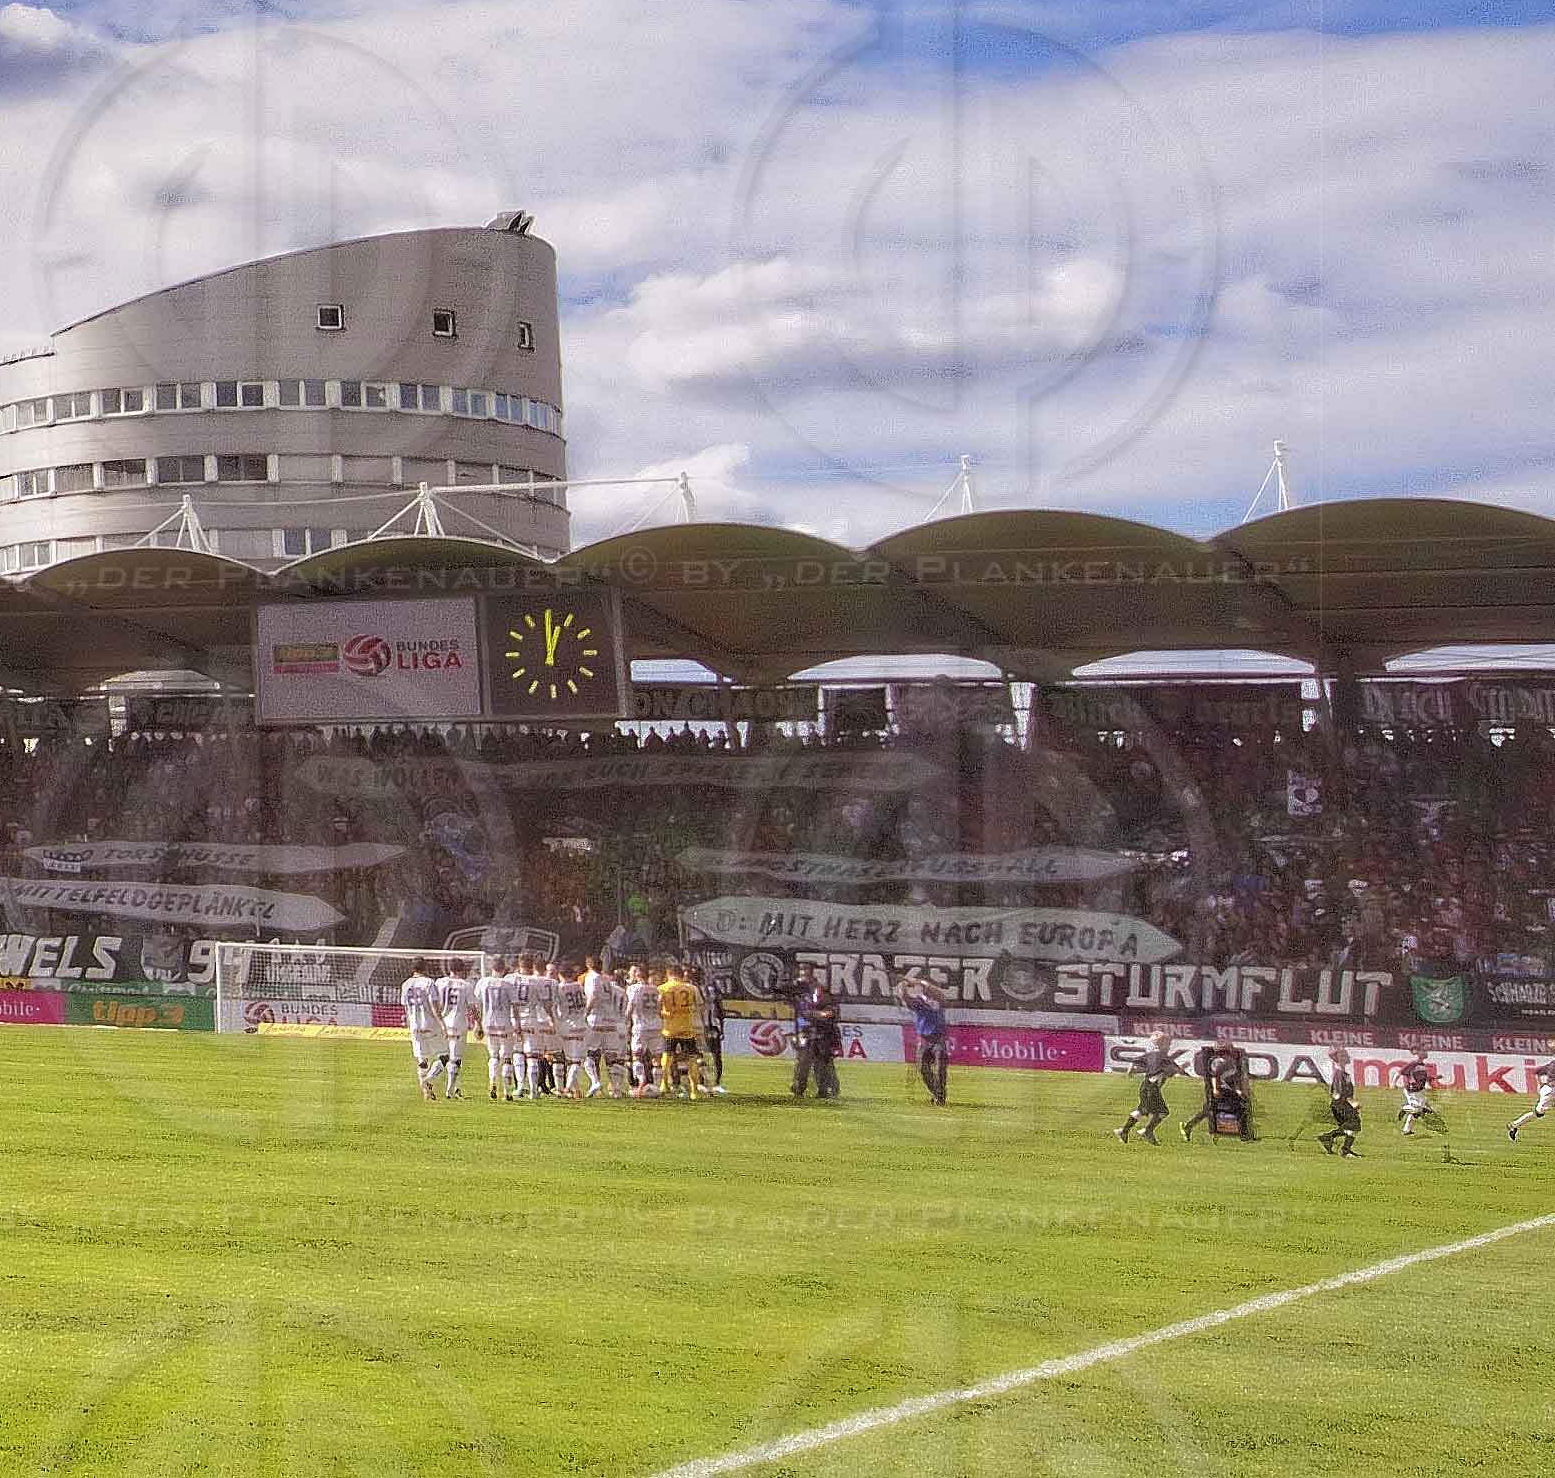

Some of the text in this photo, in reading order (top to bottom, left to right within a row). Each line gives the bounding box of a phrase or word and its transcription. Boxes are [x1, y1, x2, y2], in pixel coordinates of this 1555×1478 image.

[396, 638, 459, 651] BUNDES
[396, 650, 464, 670] LIGA
[758, 912, 815, 937] MIT
[822, 914, 902, 942] HERZ
[920, 919, 1004, 946] NACH
[1018, 920, 1139, 957] EUROPA
[1054, 961, 1394, 1016] STURMFLUT
[280, 1003, 339, 1016] BUNDES
[1309, 1029, 1374, 1046] KLEINE
[1398, 1033, 1464, 1050] KLEINE
